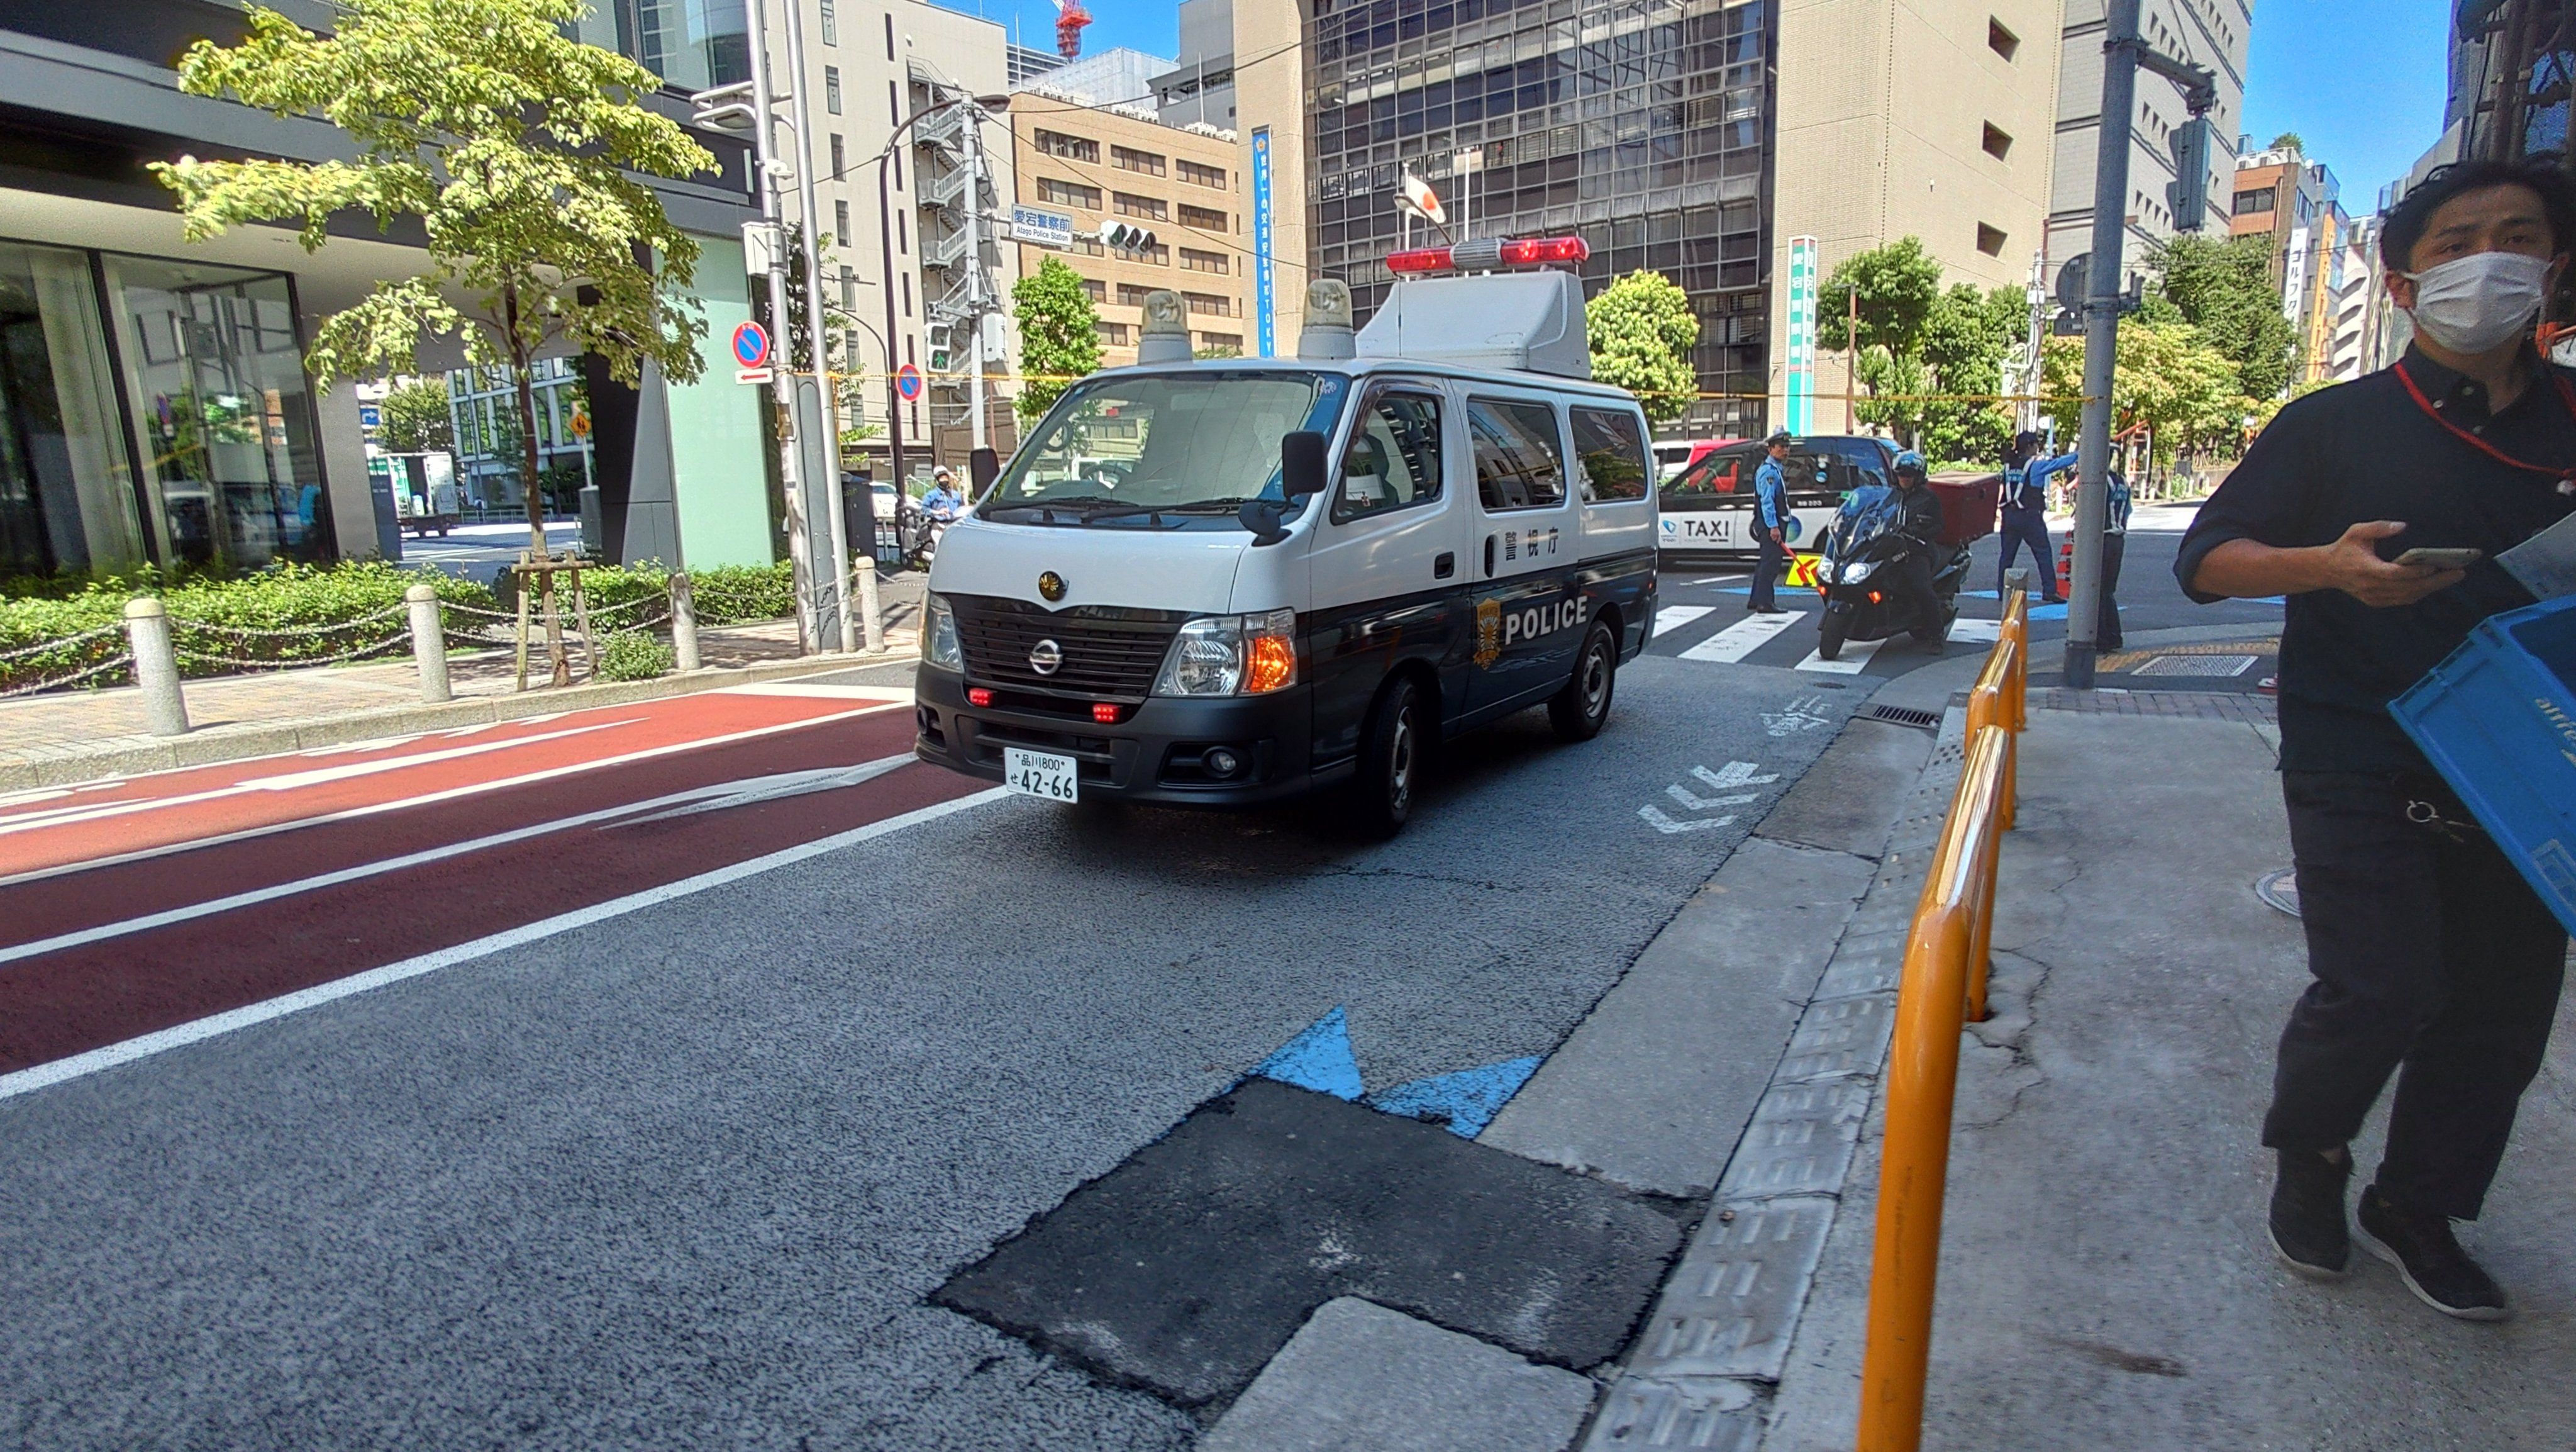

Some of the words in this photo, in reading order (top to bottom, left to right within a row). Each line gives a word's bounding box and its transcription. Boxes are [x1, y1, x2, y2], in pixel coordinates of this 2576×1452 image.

[1014, 209, 1070, 233] 愛宕警察前
[1017, 226, 1031, 236] Atago
[1033, 229, 1049, 238] Police
[1051, 232, 1068, 242] Station
[1684, 520, 1728, 537] TAXI
[1505, 527, 1558, 561] 警視庁
[1505, 596, 1588, 645] POLICE
[1010, 773, 1018, 785] せ
[1021, 769, 1073, 799] 42-66
